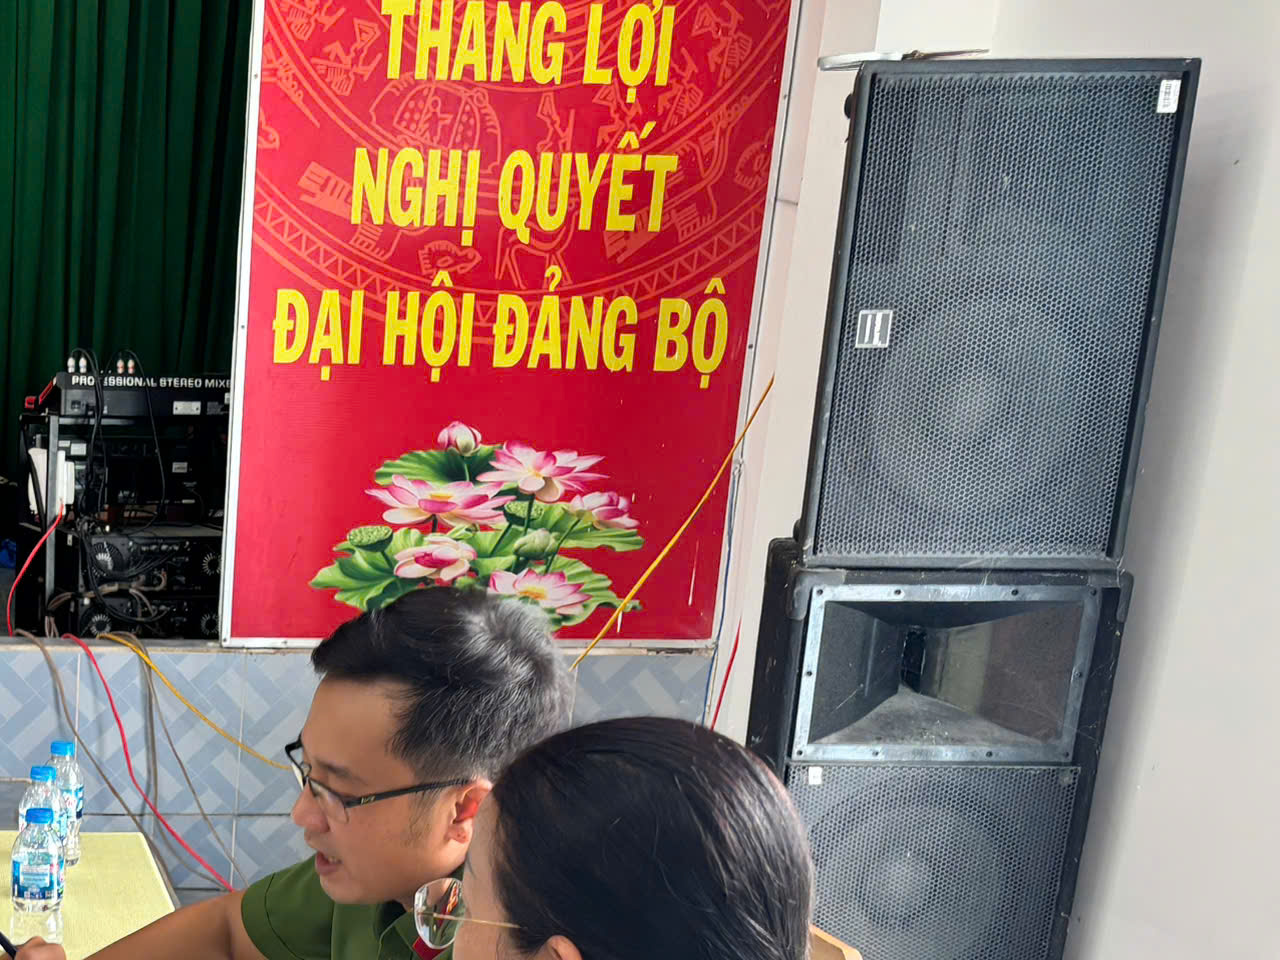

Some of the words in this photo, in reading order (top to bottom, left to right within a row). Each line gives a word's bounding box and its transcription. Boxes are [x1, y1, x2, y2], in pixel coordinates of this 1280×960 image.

[584, 0, 675, 102] LỢI
[351, 148, 479, 246] NGHỊ
[498, 121, 678, 245] QUYẾT
[72, 374, 157, 388] PROESSIONAL
[159, 376, 202, 389] STEREO
[272, 287, 364, 381] ĐẠI
[382, 271, 476, 382] HỘI
[493, 266, 638, 374] ĐẢNG
[654, 277, 729, 389] BỘ
